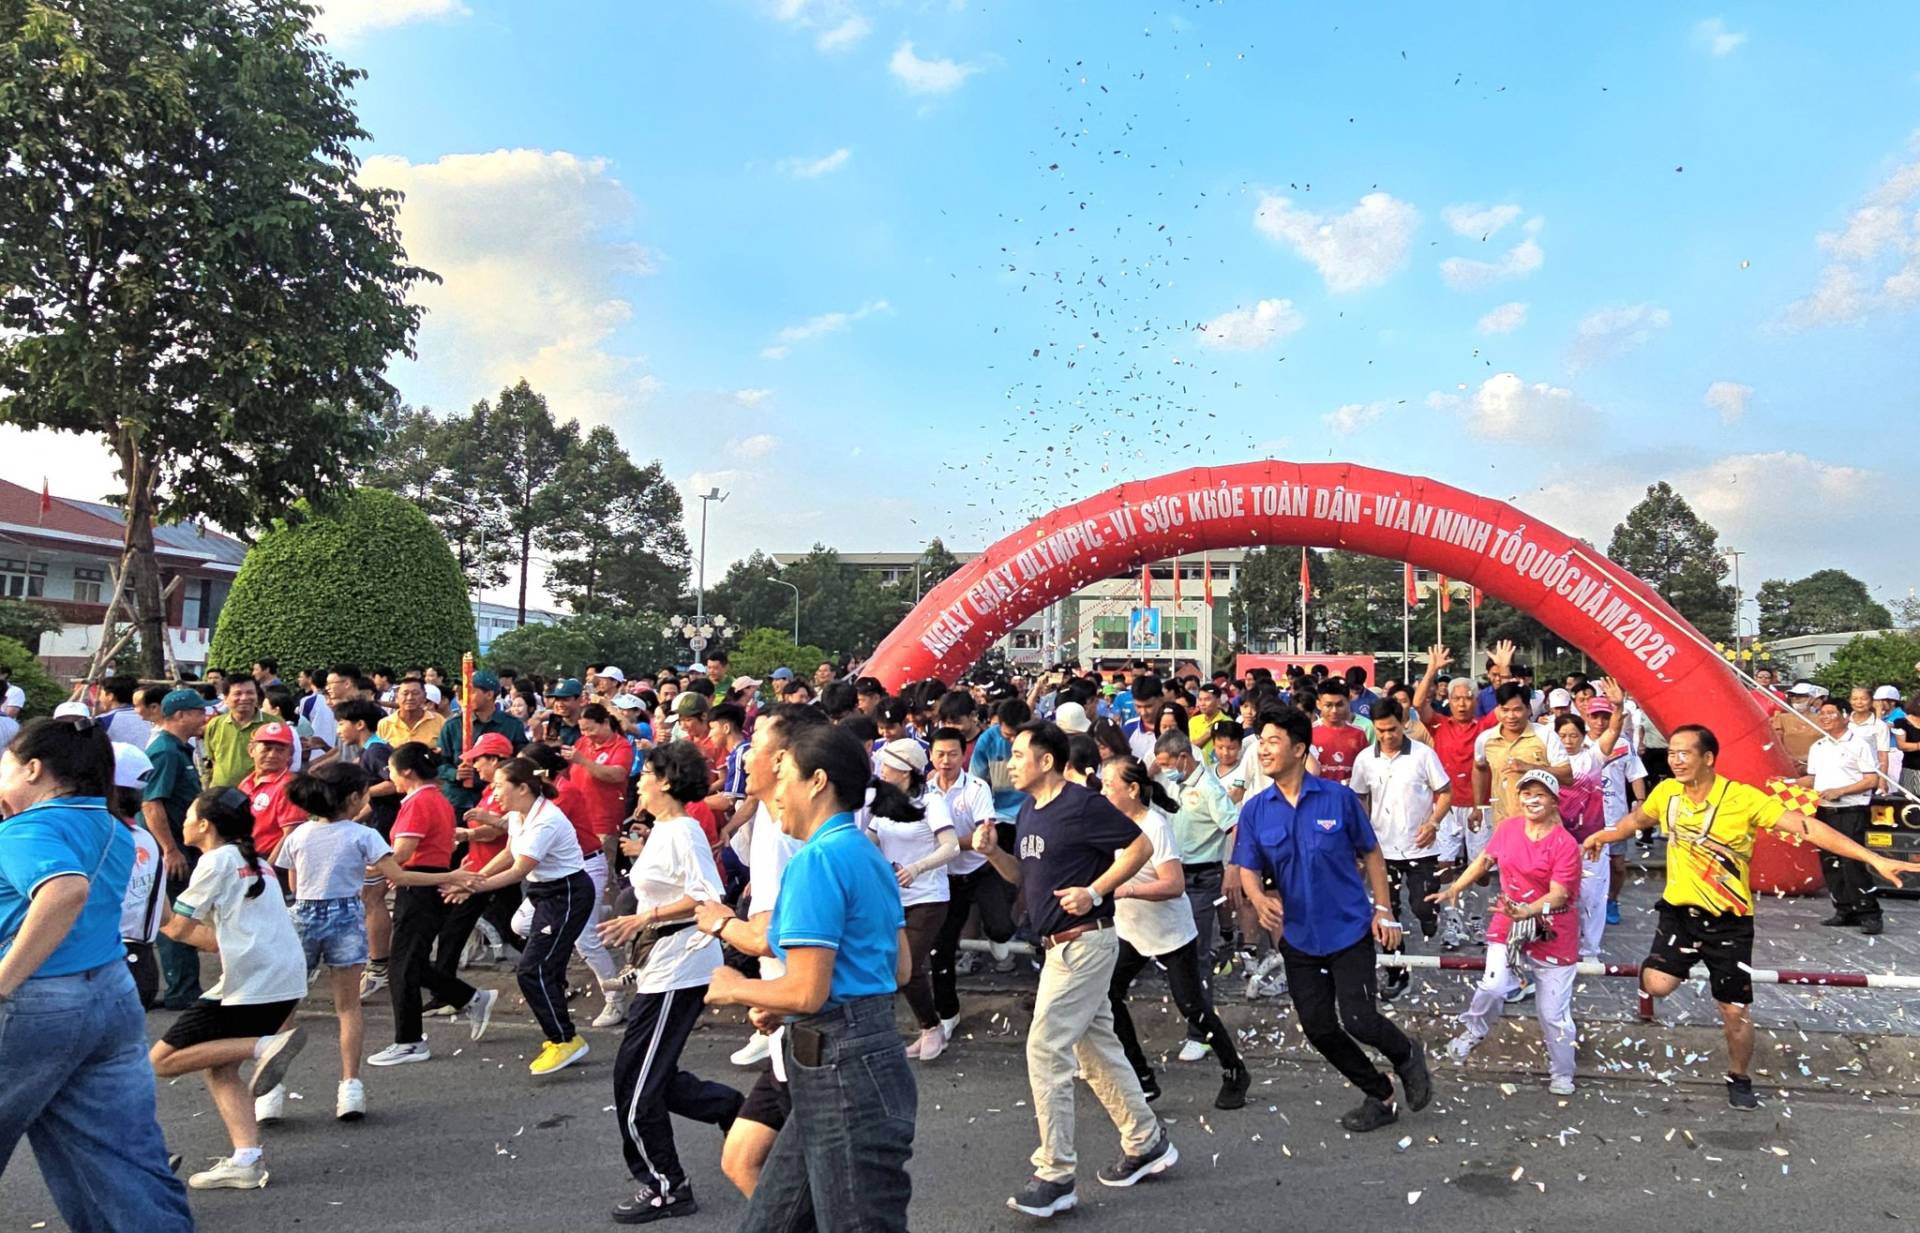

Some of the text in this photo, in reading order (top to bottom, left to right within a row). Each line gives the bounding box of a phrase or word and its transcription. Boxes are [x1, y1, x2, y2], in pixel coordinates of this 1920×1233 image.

[920, 600, 975, 660] NGÀY
[1017, 519, 1104, 581] OLYMPIC
[1141, 495, 1184, 533] SỨC
[1188, 480, 1245, 522] KHỎE
[1251, 480, 1309, 517] TOÀN
[1314, 485, 1362, 524] DÂN
[1393, 500, 1433, 536] AN
[1431, 508, 1493, 554] NINH
[1488, 524, 1527, 565] TỔ
[1515, 541, 1581, 596] QUỐC
[1567, 574, 1632, 632] NĂM
[1020, 834, 1045, 860] GAP
